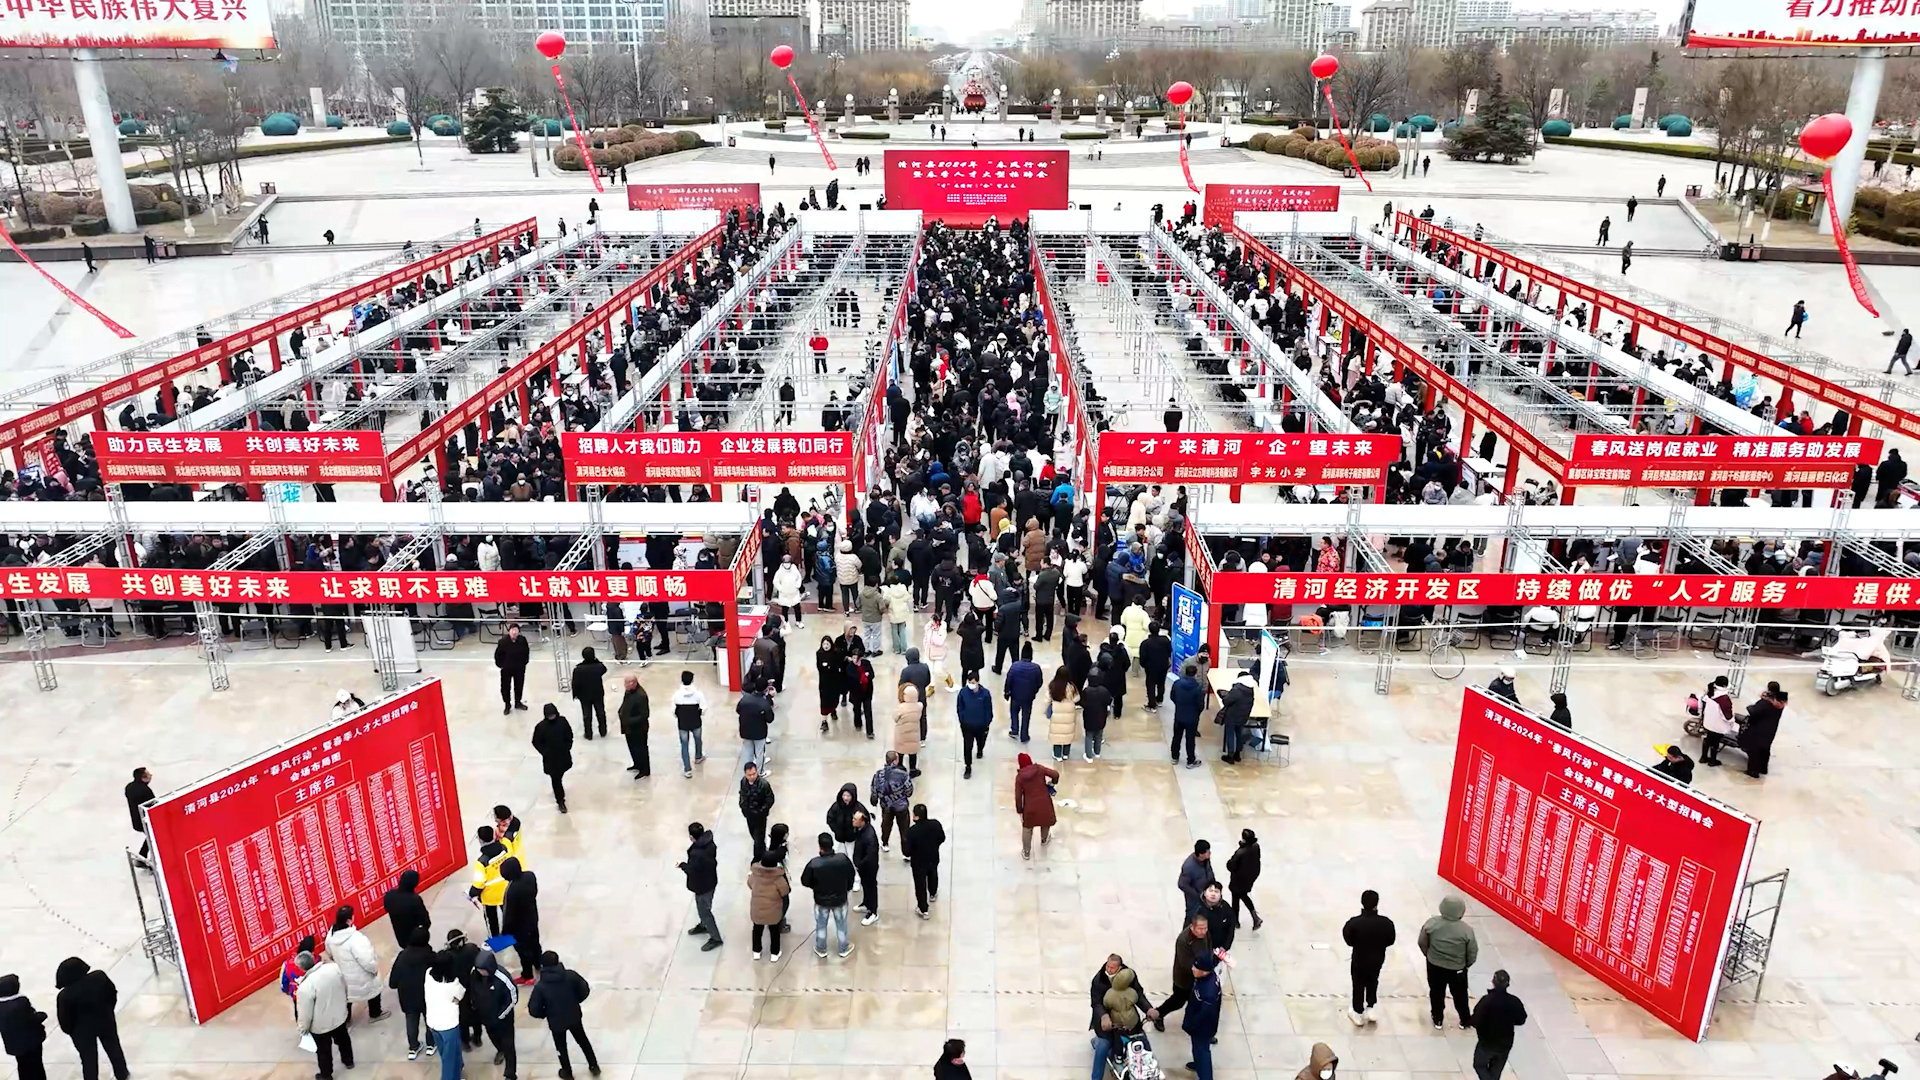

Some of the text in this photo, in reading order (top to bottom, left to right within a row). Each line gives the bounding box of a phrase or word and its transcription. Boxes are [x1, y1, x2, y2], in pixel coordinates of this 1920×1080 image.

[0, 0, 248, 21] 中华民族伟大复兴
[1786, 0, 1920, 18] 着力推动
[107, 437, 359, 453] 助力民生发展 共创美好未来
[578, 438, 843, 454] 招聘人才我们助力 企业发展我们同行
[1591, 440, 1861, 458] 春风送岗促就业 精准服务助发展
[1102, 464, 1164, 478] 中国联通清河分公司
[0, 572, 686, 598] 生发展 共创美好未来 让求职不再难 让就业更顺畅
[1274, 578, 1480, 599] 清河经济开发区
[1853, 581, 1920, 605] 提供
[294, 774, 335, 803] 主席台
[1558, 786, 1600, 818] 主席台
